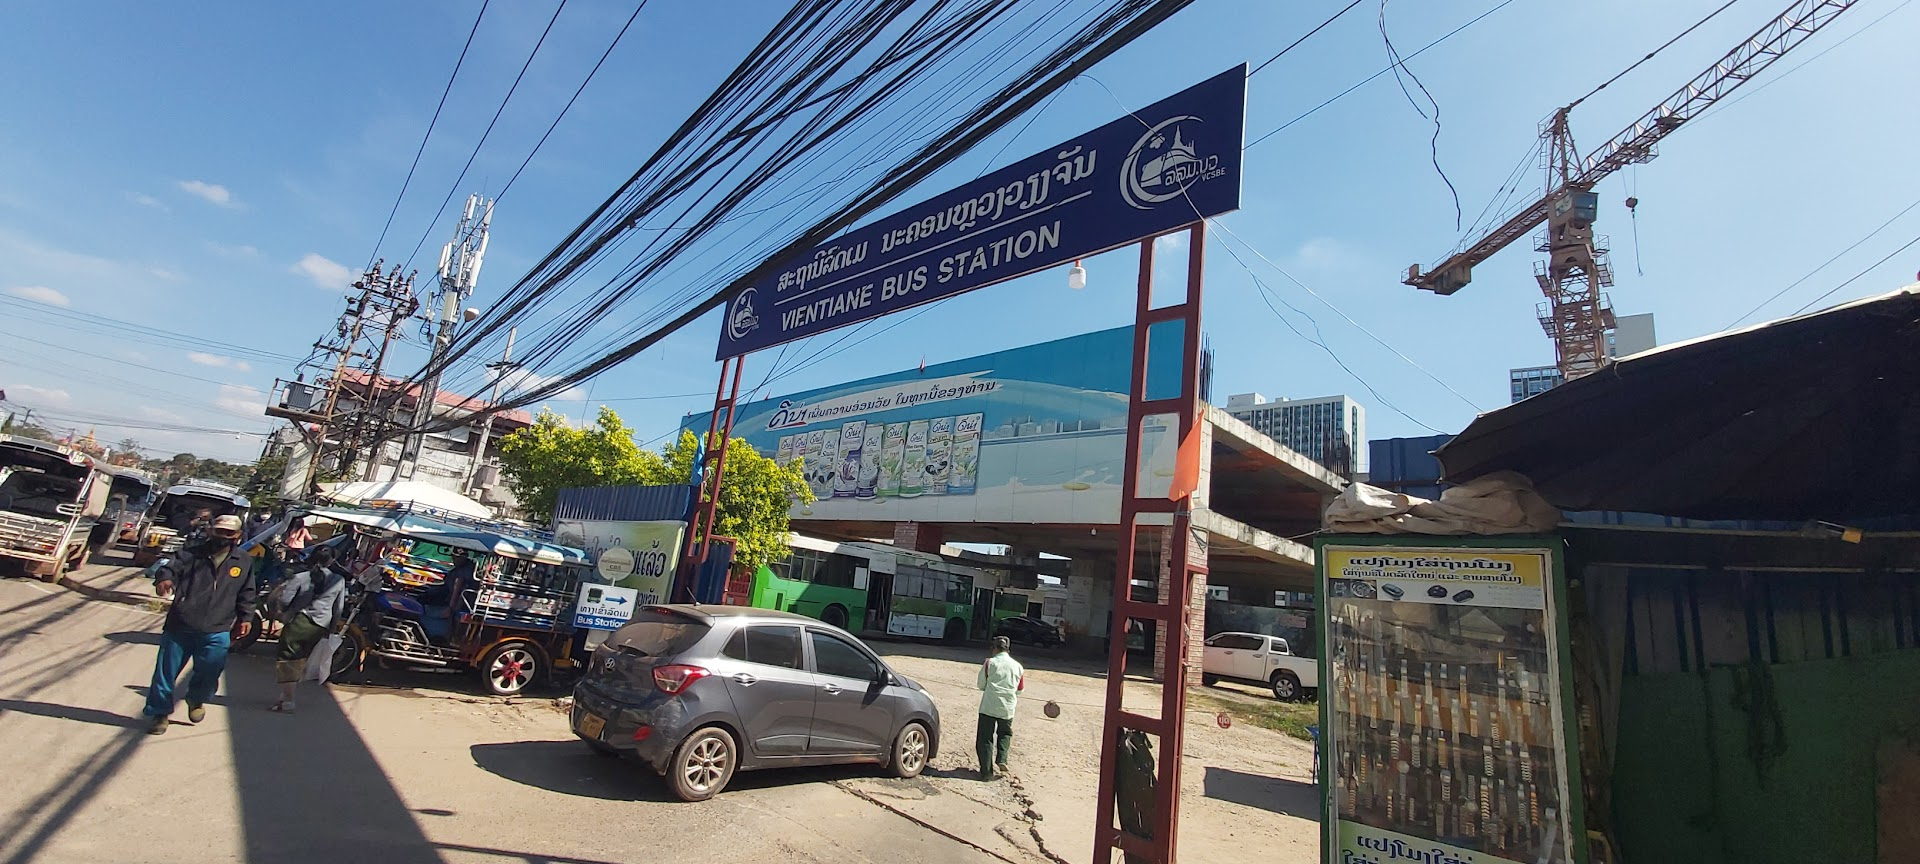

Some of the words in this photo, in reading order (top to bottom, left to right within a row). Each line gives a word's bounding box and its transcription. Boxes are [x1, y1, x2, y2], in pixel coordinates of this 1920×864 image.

[1201, 166, 1227, 182] VCSBE
[781, 283, 874, 332] VIENTIANE
[880, 266, 928, 302] BUS
[937, 220, 1061, 284] STATION
[577, 615, 594, 625] Bus
